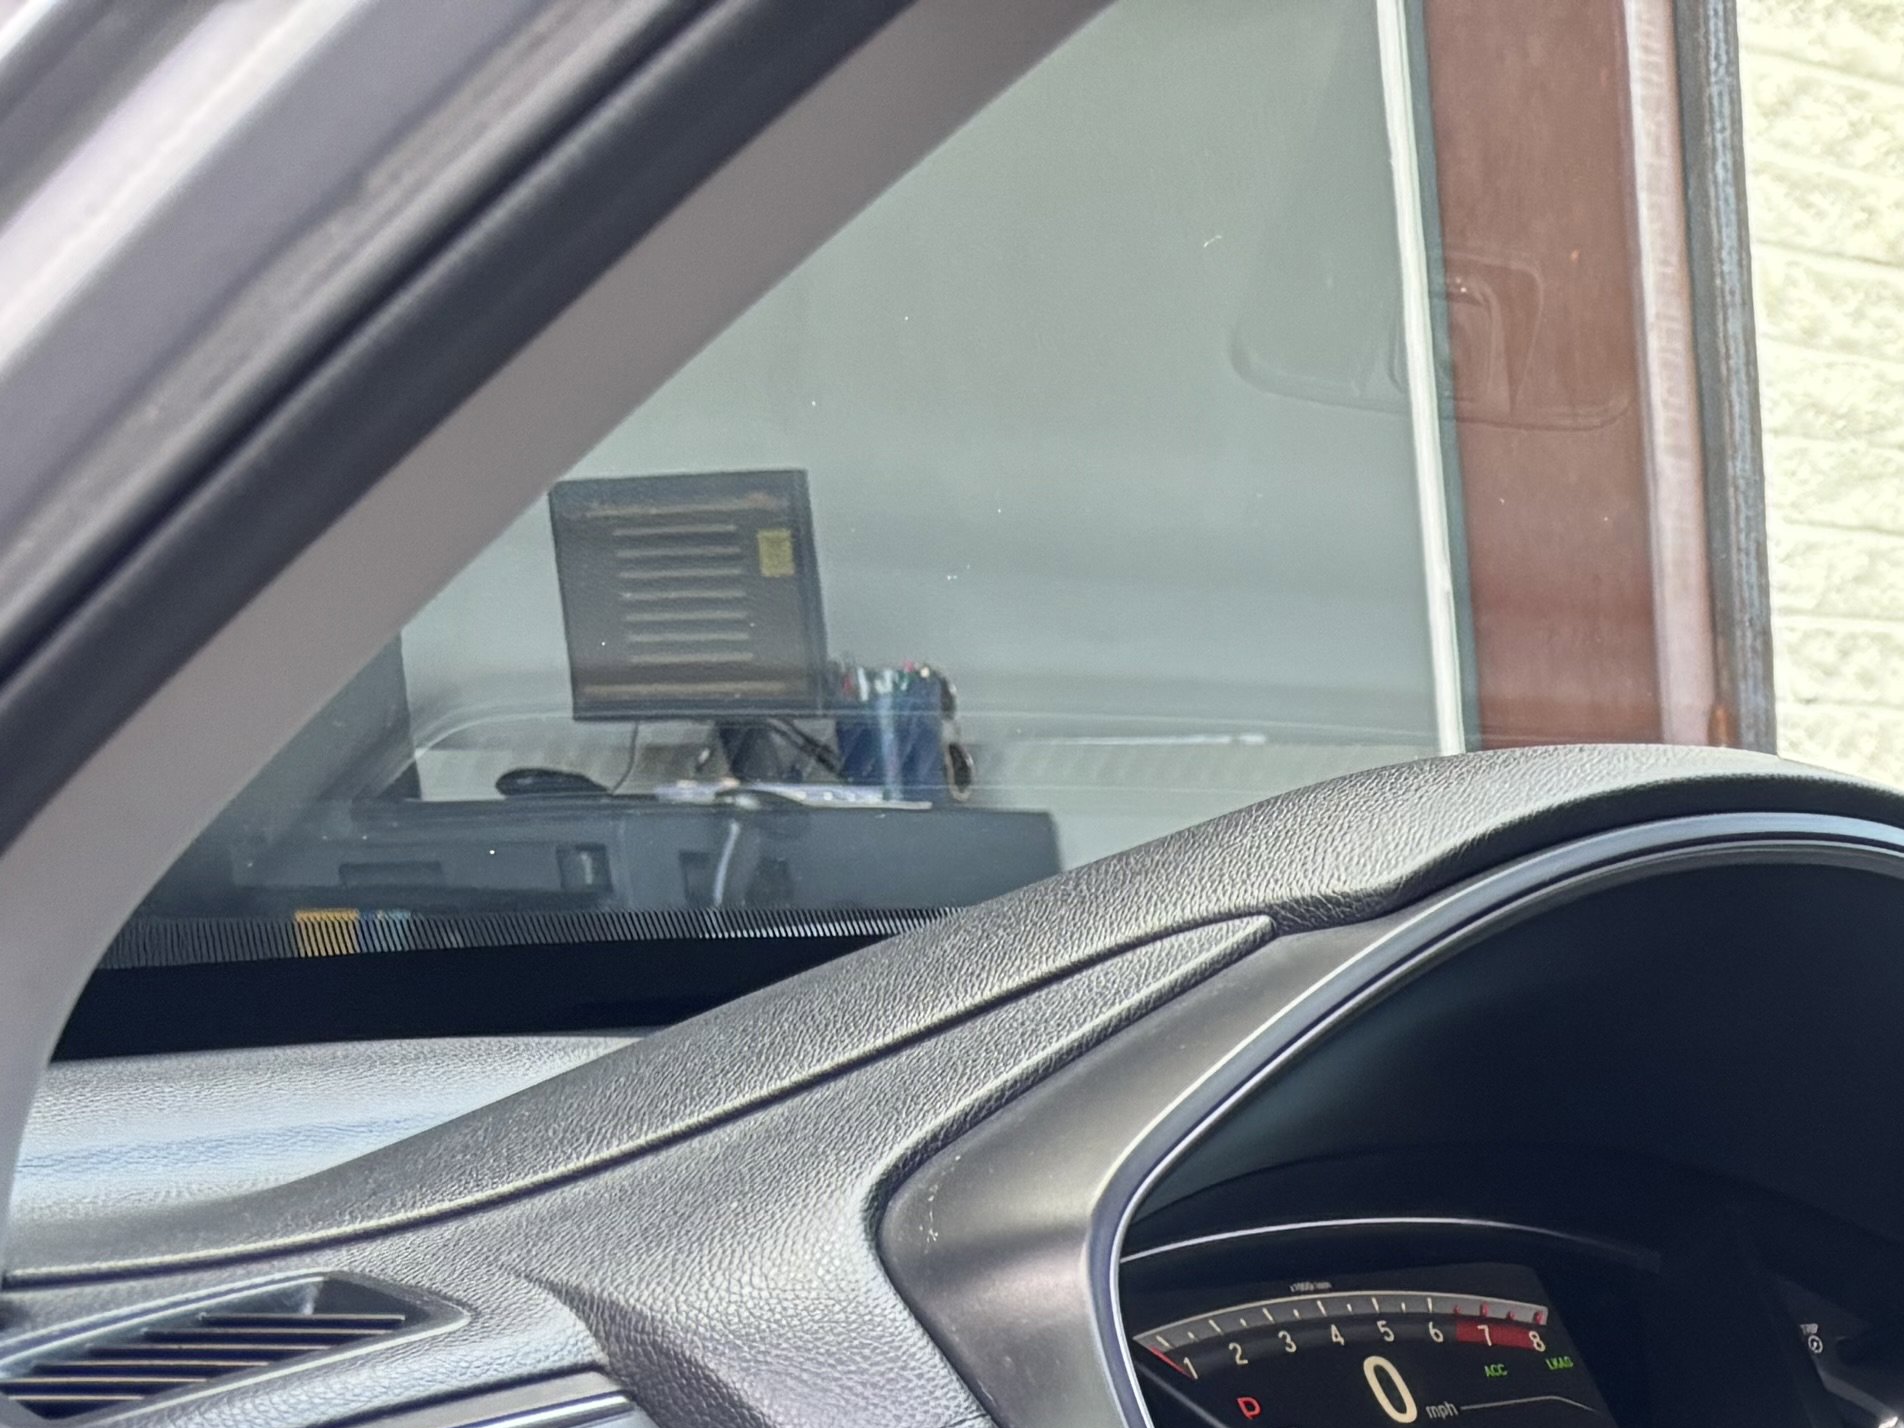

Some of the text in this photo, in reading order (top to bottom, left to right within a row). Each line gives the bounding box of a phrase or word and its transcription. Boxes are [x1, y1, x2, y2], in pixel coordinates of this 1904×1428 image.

[1184, 1320, 1546, 1379] 1 2 3 4 5 6 7 8
[1363, 1355, 1459, 1424] 0 mph
[1484, 1364, 1508, 1378] ACC
[1236, 1397, 1262, 1419] P
